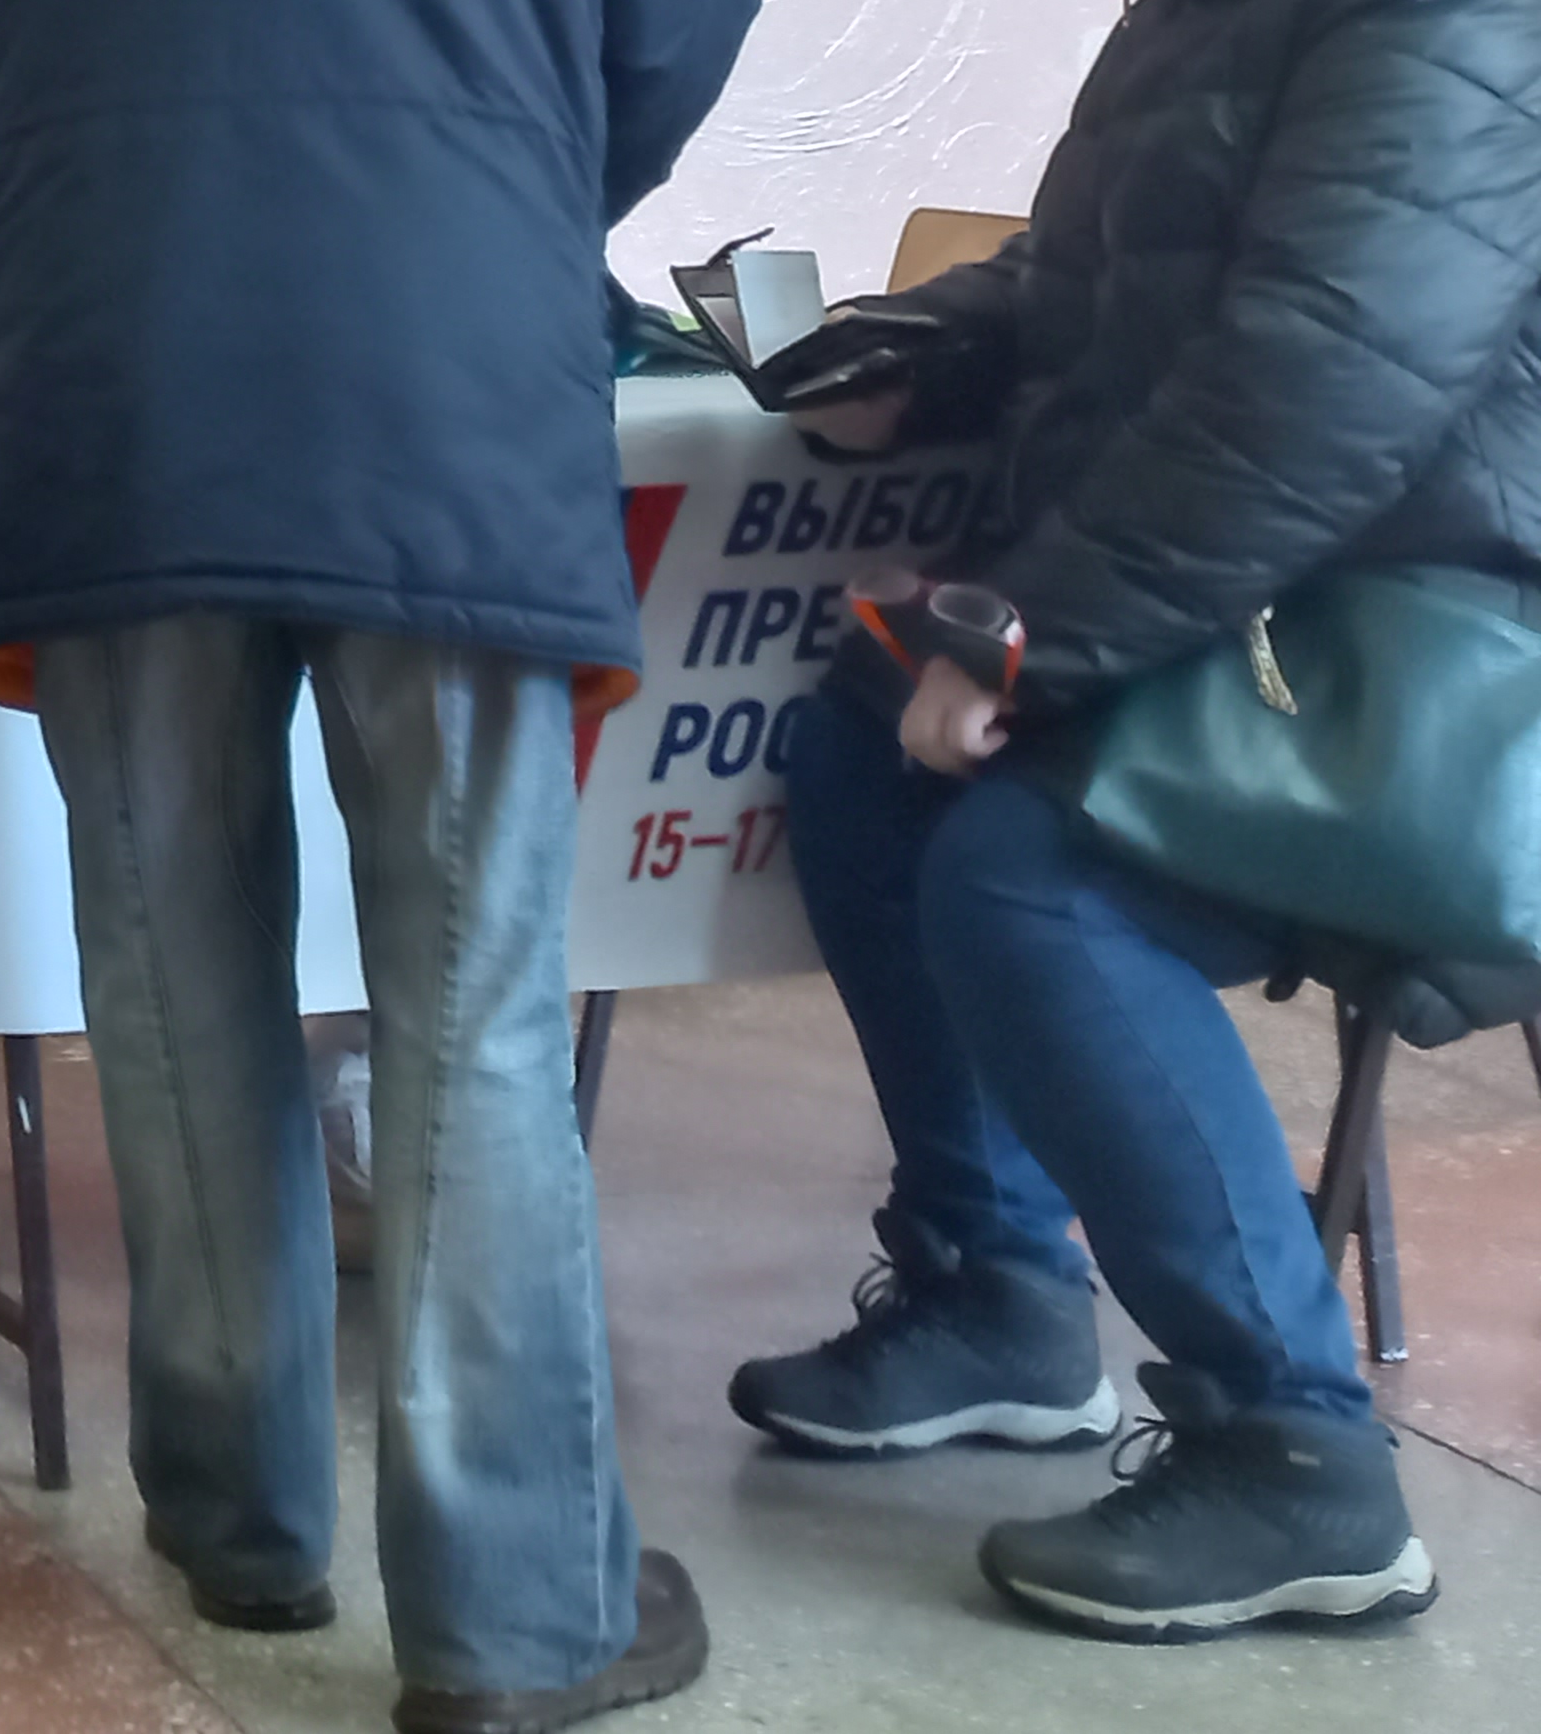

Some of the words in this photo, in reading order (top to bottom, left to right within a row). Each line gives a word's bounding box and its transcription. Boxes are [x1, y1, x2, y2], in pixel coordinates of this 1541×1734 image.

[722, 470, 985, 558] ВЫБО
[682, 584, 845, 669] ПРЕ
[649, 695, 799, 784] РОС
